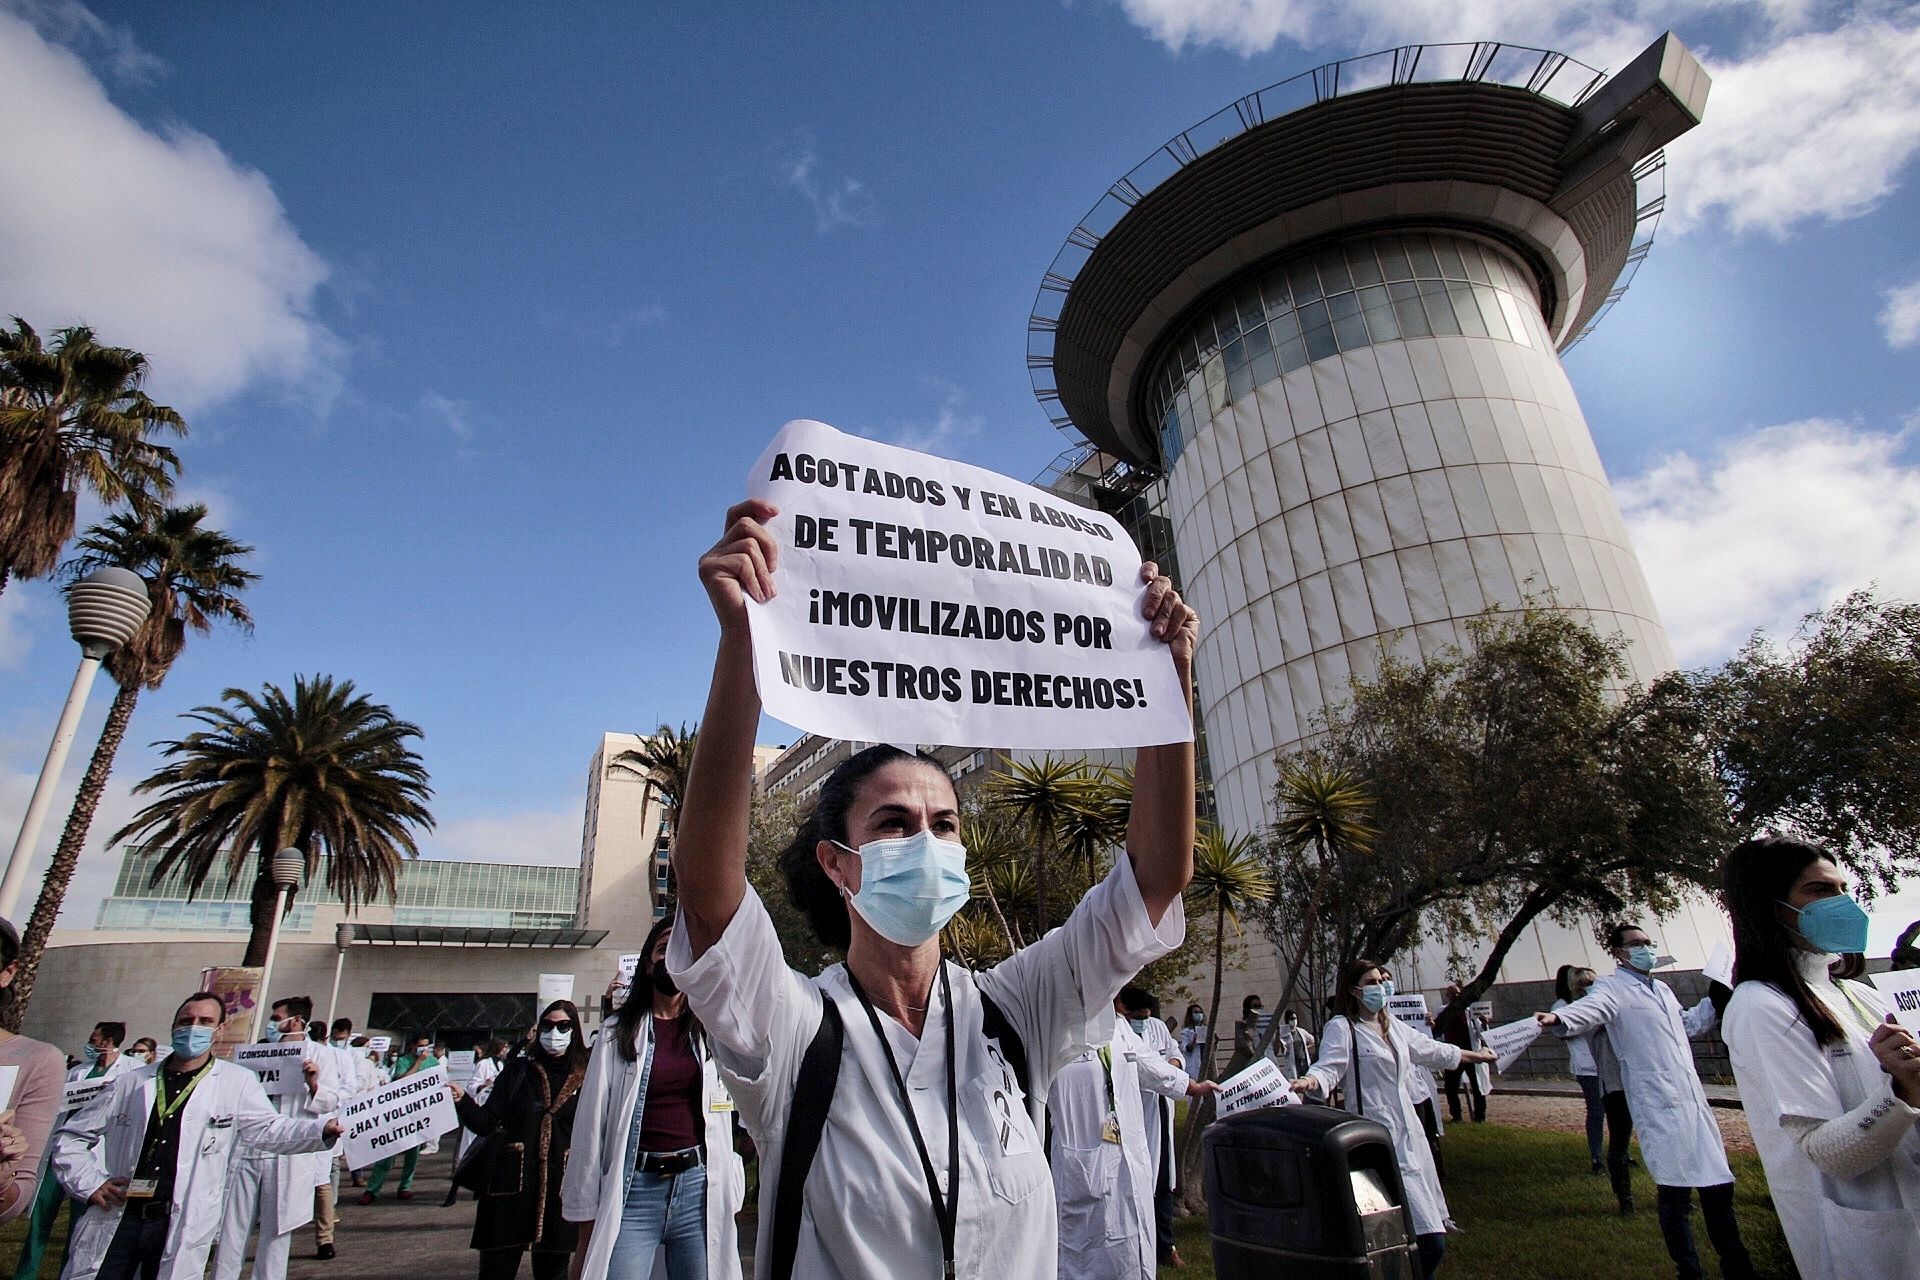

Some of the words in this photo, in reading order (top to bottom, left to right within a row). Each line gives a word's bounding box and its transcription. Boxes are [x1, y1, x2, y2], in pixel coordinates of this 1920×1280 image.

[769, 452, 946, 506] AGOTADOS
[952, 485, 971, 511] Y
[980, 490, 1022, 520] EN
[1029, 501, 1114, 542] ABUSO
[794, 513, 839, 552] DE
[848, 517, 1113, 588] TEMPORALIDAD
[808, 588, 1046, 644] ¡MOVILIZADOS
[1054, 612, 1113, 650] POR
[778, 650, 962, 703] NUESTROS
[971, 668, 1148, 710] DERECHOS!
[1394, 1013, 1424, 1021] OLUNTAD
[258, 1070, 280, 1083] YA!
[346, 1098, 374, 1116] ¡HAY
[377, 1074, 440, 1105] CONSENSO!
[1220, 1079, 1251, 1101] AGOTADOS
[1249, 1076, 1256, 1085] Y
[1226, 1103, 1234, 1112] DE
[1235, 1078, 1282, 1108] TEMPORALIDAD
[349, 1115, 380, 1139] ¿HAY
[383, 1091, 444, 1123] VOLUNTAD
[370, 1116, 431, 1149] POLÍTICA?
